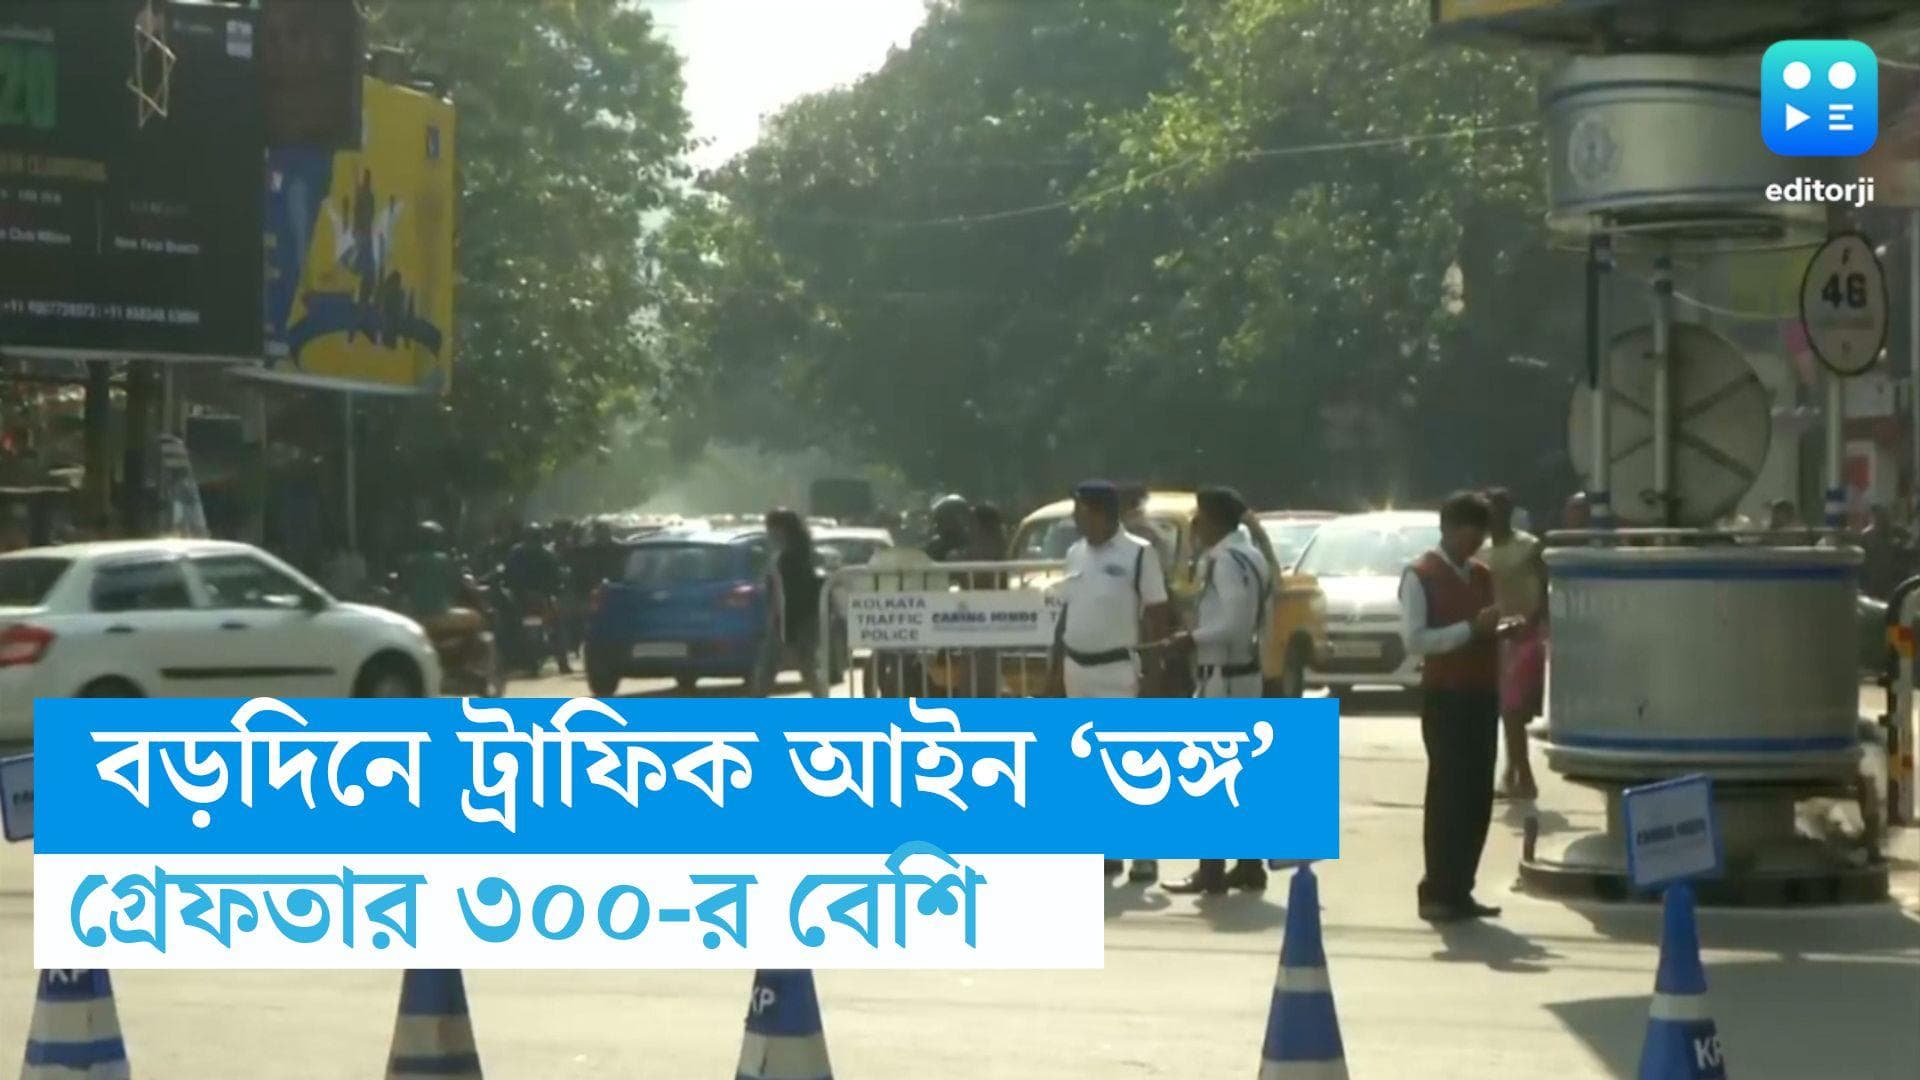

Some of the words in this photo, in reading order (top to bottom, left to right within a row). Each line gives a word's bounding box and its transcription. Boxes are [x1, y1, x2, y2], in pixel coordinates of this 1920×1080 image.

[1821, 272, 1868, 309] 46
[852, 598, 925, 609] KOLKATA
[857, 613, 922, 625] TRAFFIC
[932, 611, 986, 623] CARING
[860, 629, 919, 641] POLICE
